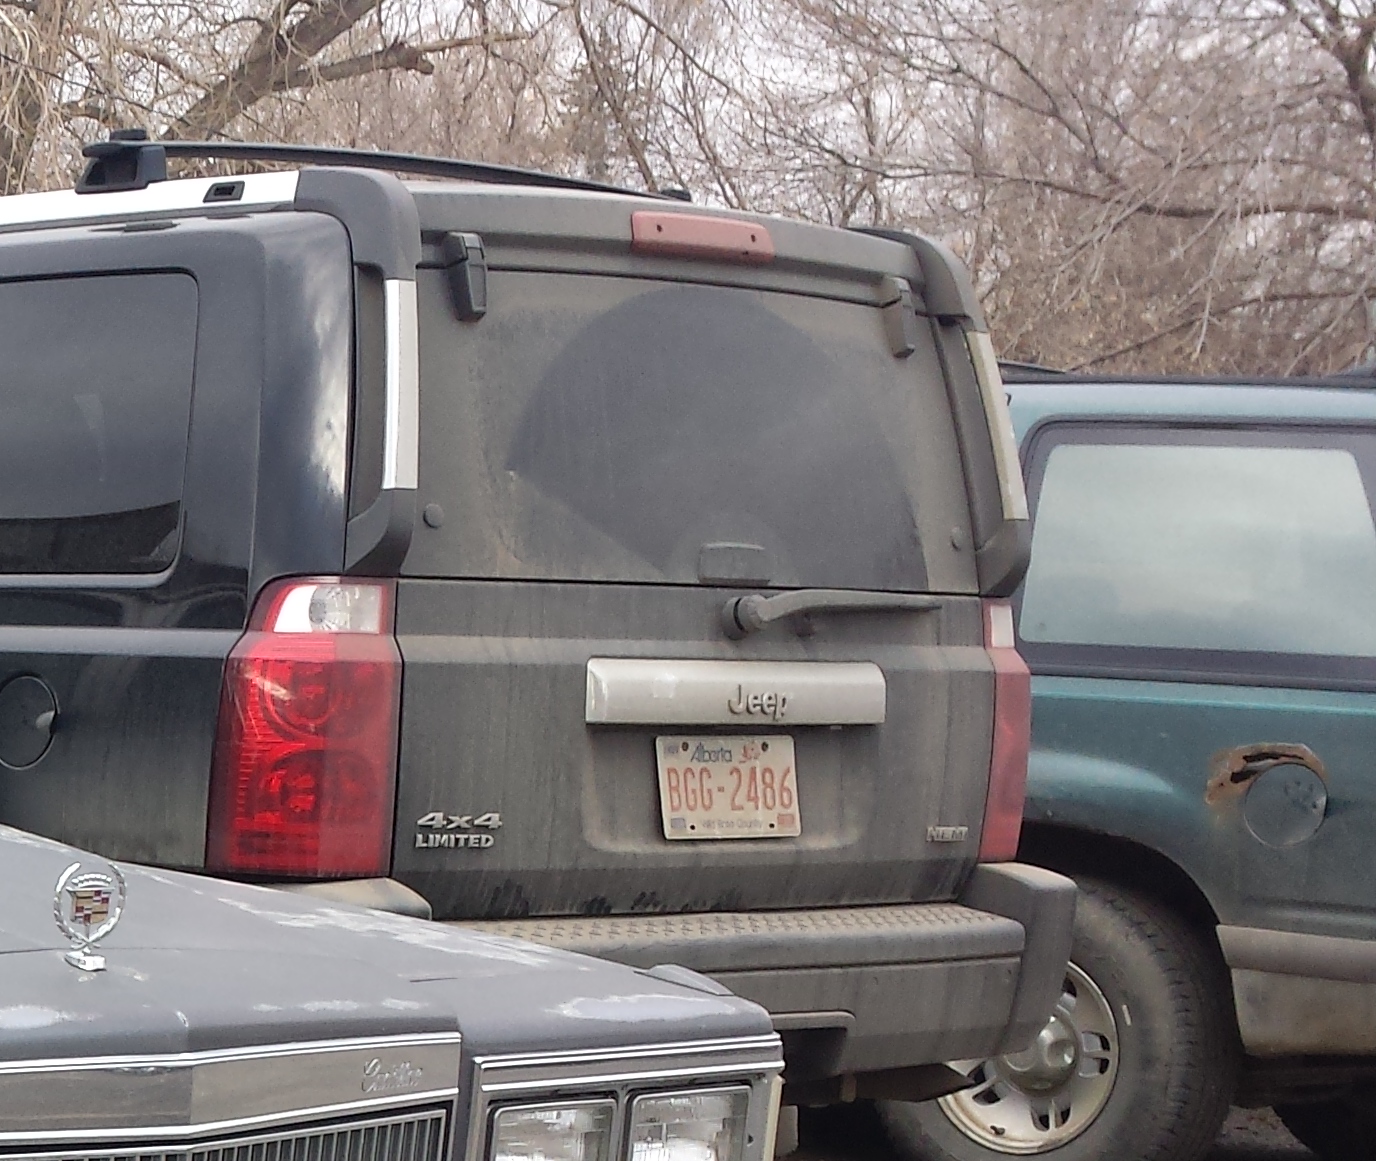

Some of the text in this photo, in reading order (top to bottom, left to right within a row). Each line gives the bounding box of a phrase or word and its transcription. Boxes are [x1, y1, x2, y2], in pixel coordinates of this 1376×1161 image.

[727, 684, 788, 721] Jeep
[690, 742, 733, 763] Alberta
[666, 766, 794, 812] BGG-2486
[415, 811, 503, 830] 4x4
[414, 832, 495, 849] LIMITED
